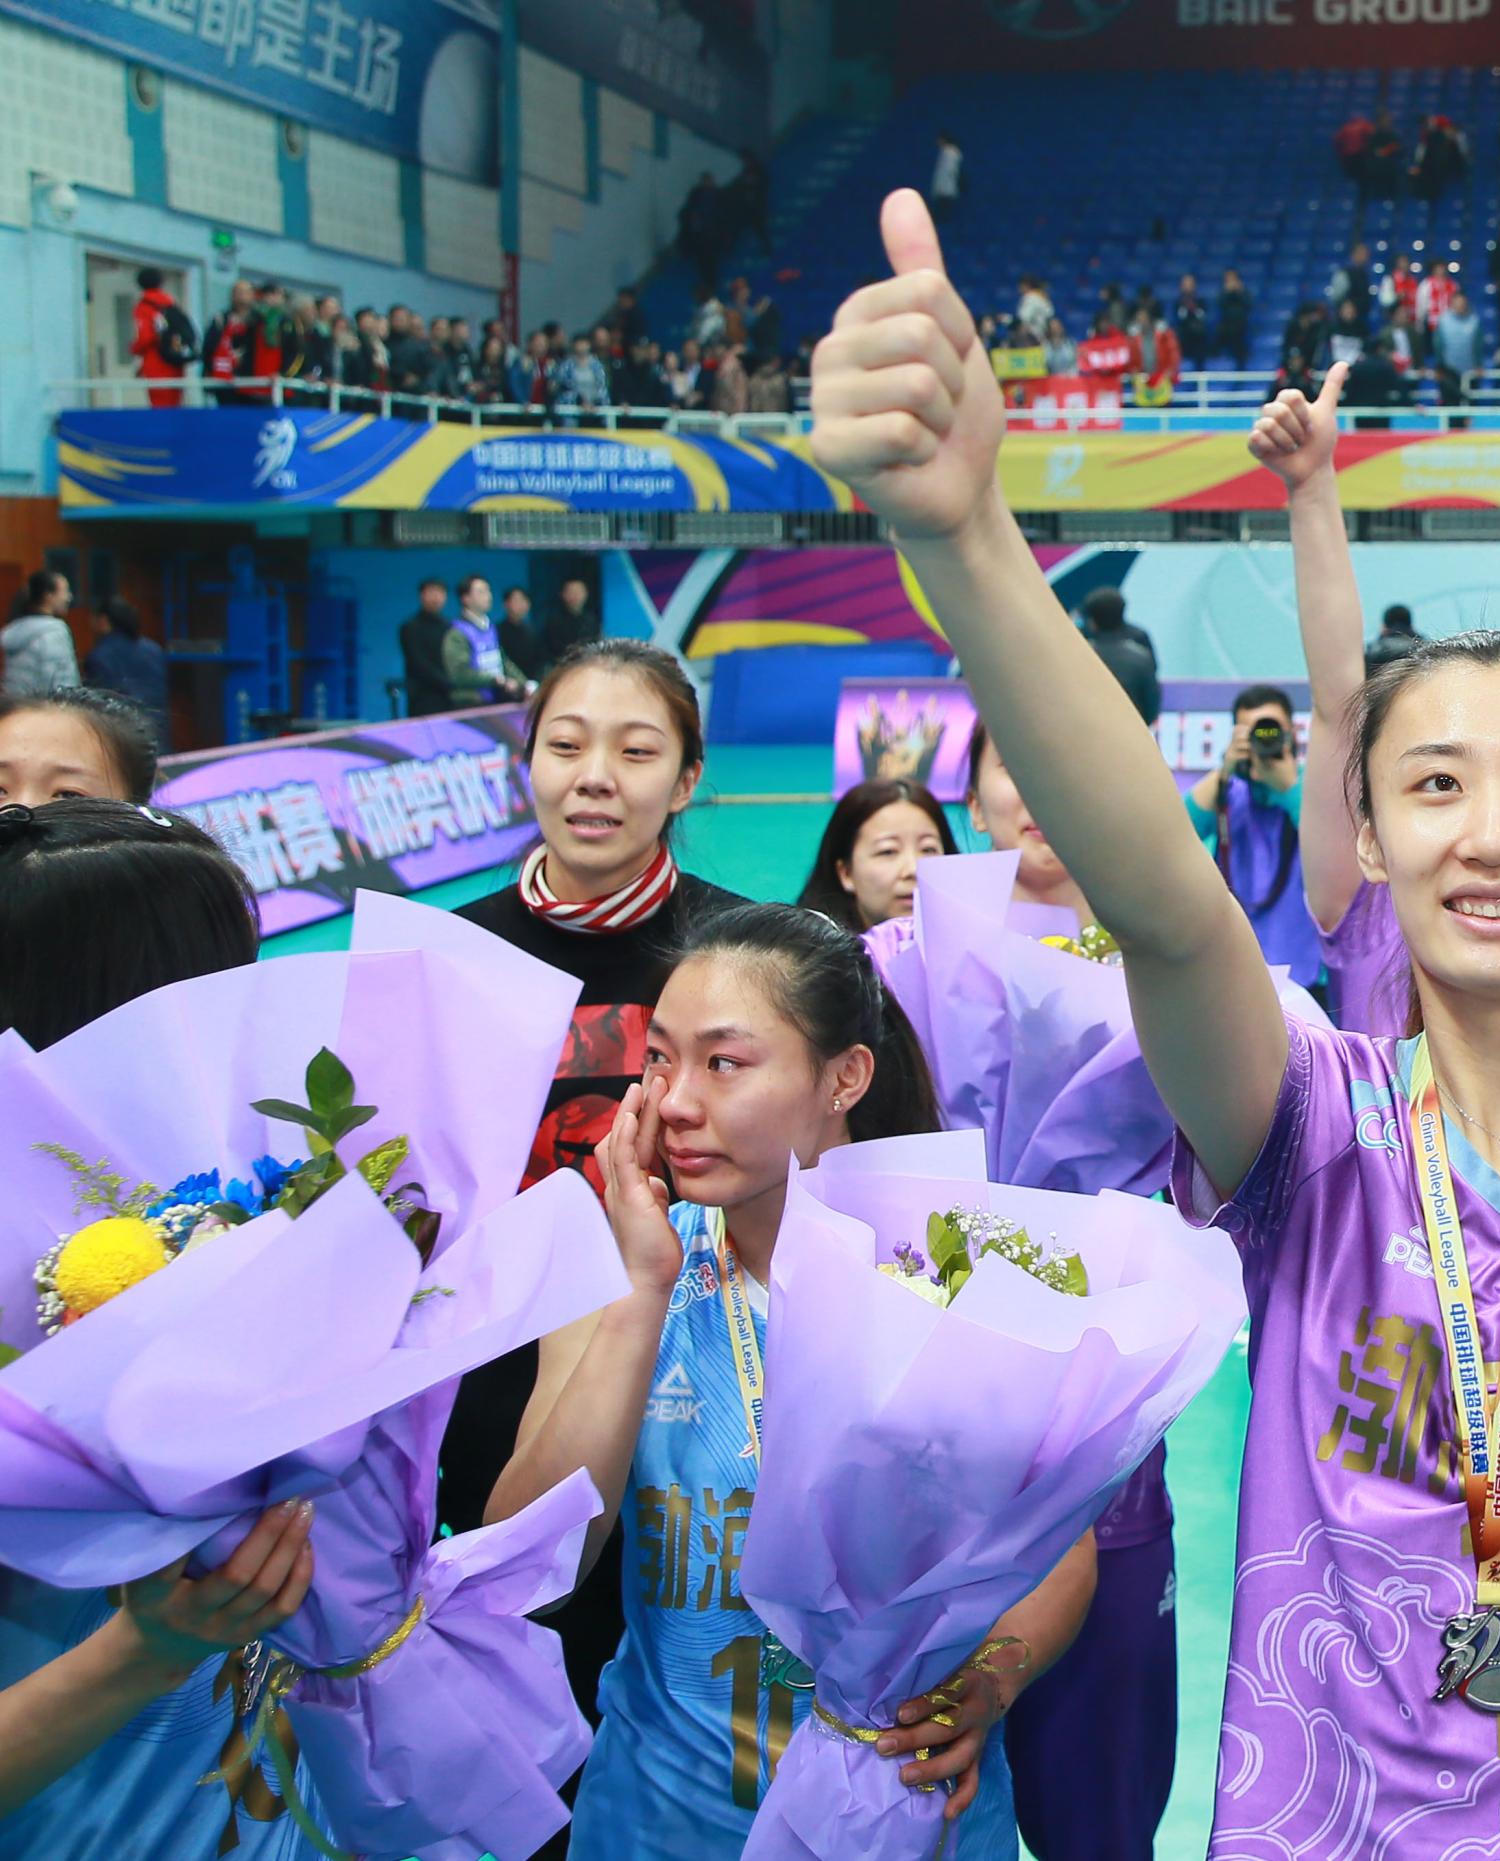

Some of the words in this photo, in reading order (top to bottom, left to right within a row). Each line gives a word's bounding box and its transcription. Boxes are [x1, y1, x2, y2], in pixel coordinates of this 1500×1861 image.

[1177, 0, 1294, 26] BAIC
[1313, 0, 1492, 25] GROUP
[610, 475, 675, 498] League
[1420, 1112, 1435, 1152] China
[1427, 1152, 1452, 1226] Volleyball
[1382, 1232, 1434, 1279] PE
[1440, 1229, 1459, 1288] League
[729, 1283, 751, 1343] Volleyball
[741, 1343, 758, 1388] League
[1449, 1302, 1489, 1475] 中国排球超级联赛
